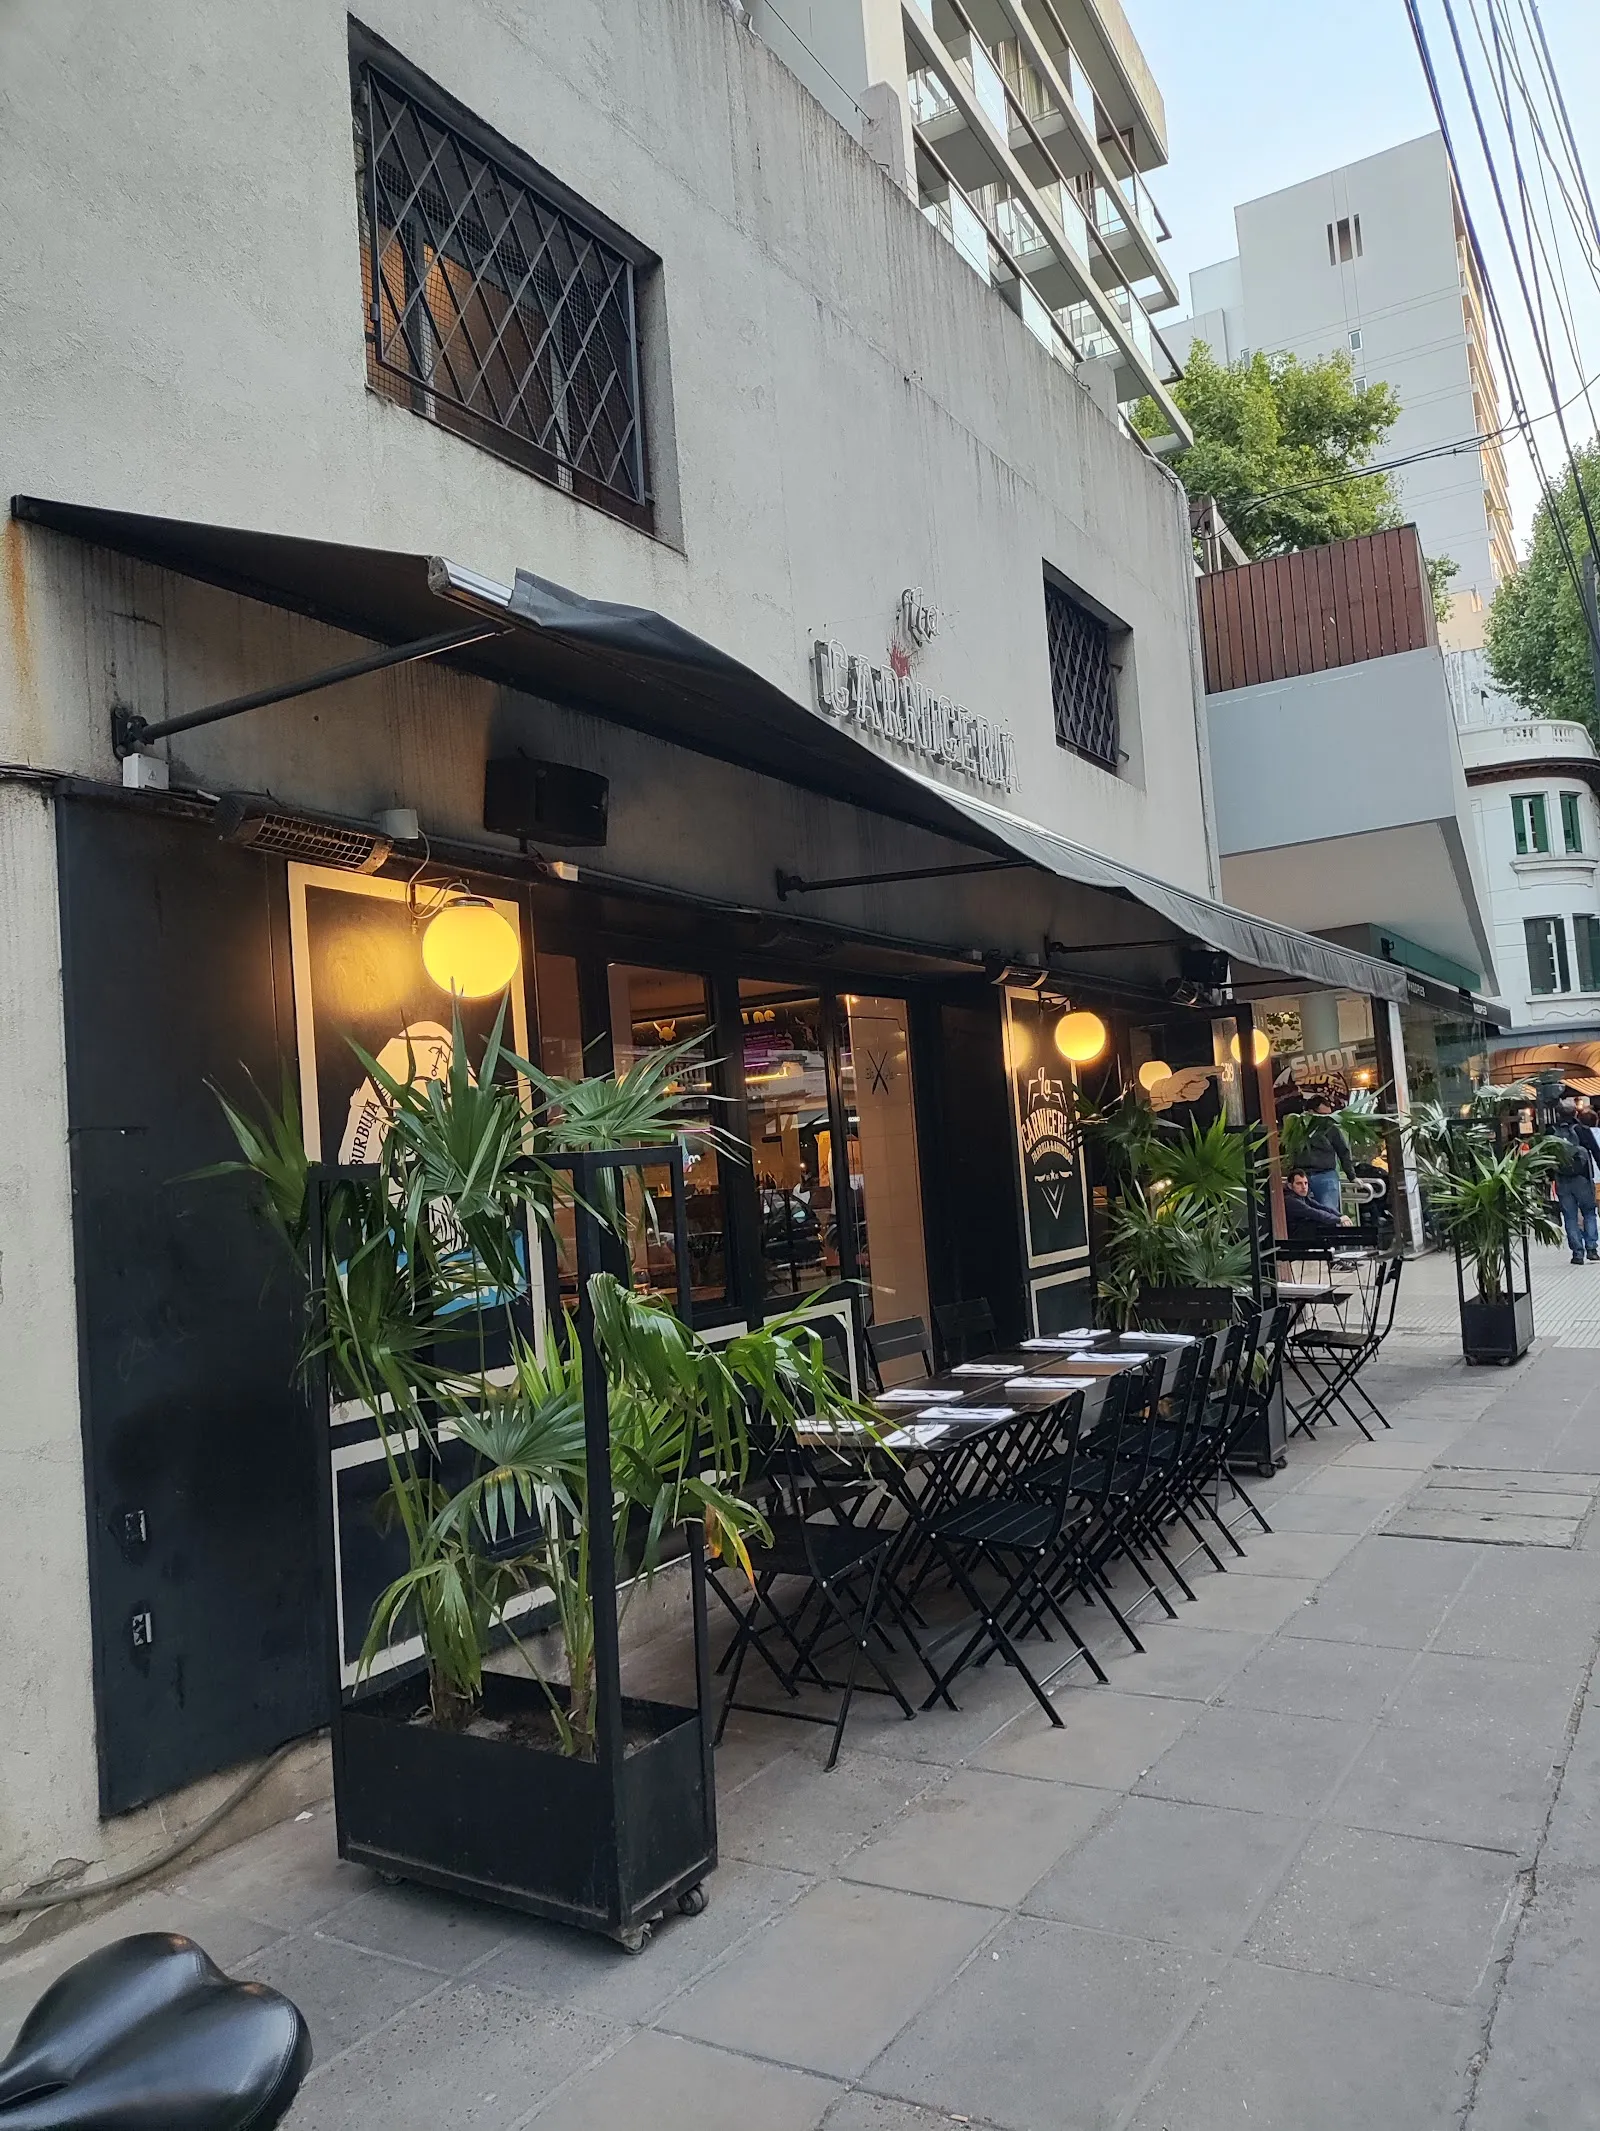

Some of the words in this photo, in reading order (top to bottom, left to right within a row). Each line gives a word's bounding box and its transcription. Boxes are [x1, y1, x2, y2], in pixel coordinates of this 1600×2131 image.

[901, 586, 940, 647] La
[813, 639, 1022, 794] CARNICERIA
[1037, 1066, 1052, 1102] La
[1290, 1045, 1358, 1078] SHOT
